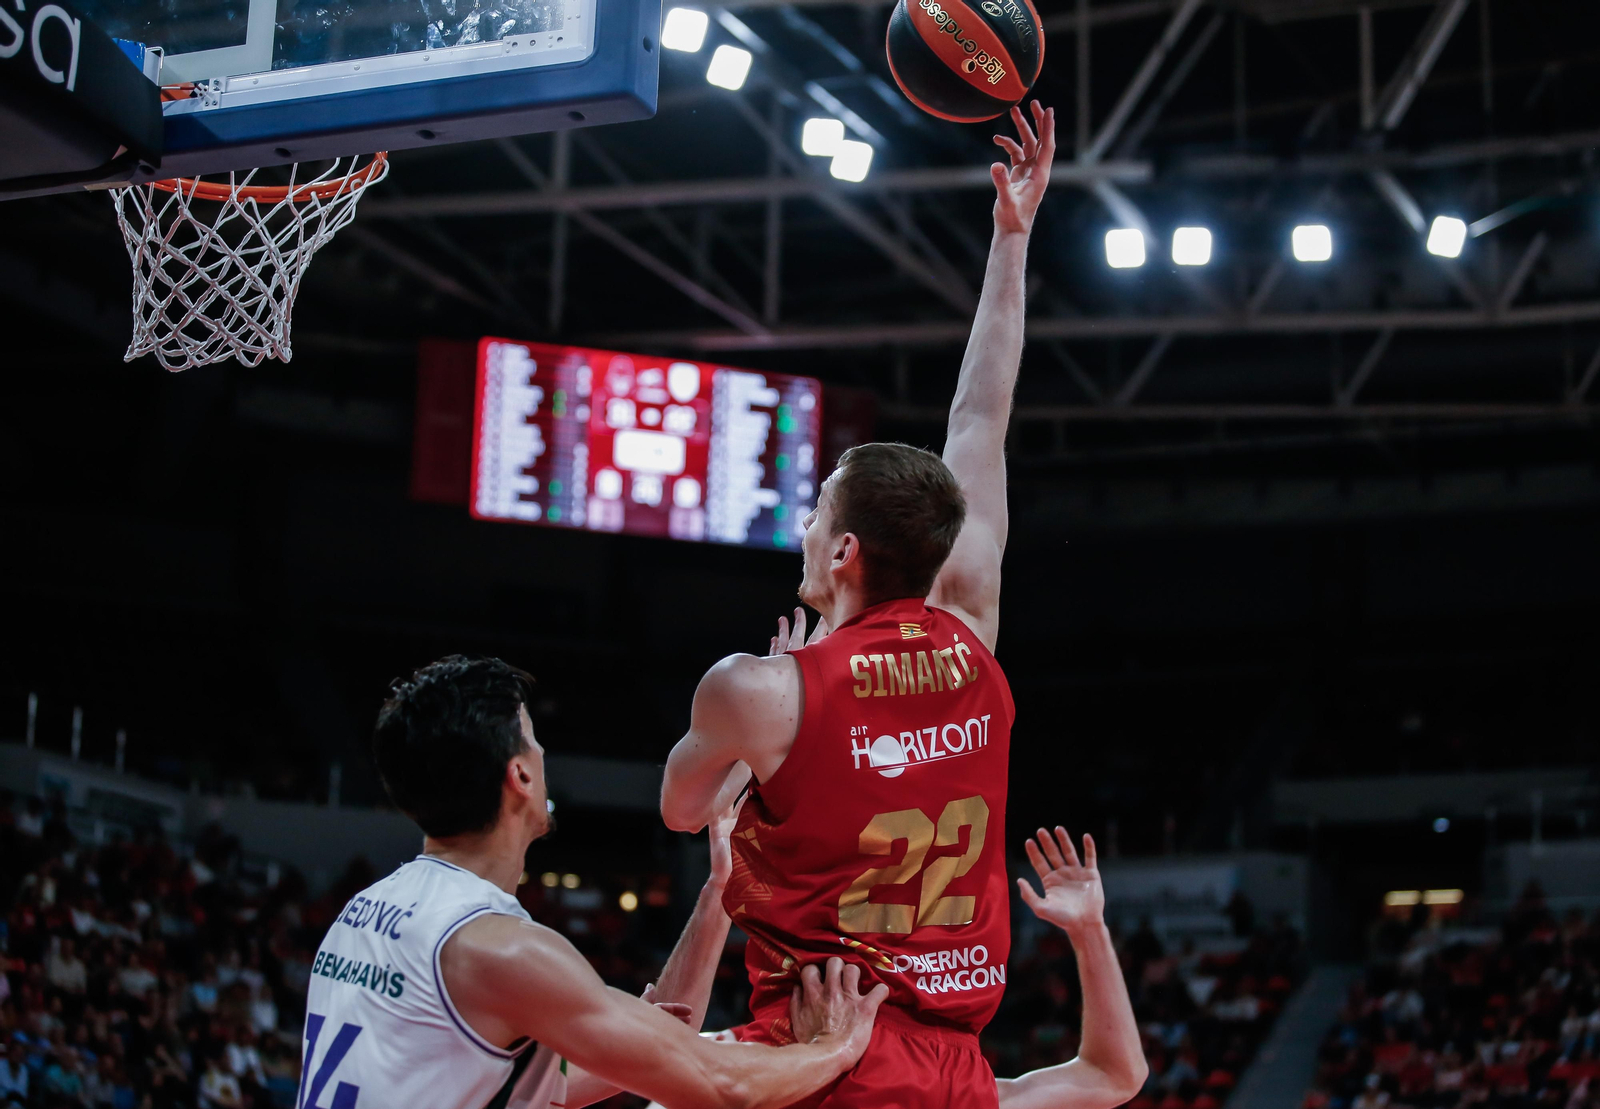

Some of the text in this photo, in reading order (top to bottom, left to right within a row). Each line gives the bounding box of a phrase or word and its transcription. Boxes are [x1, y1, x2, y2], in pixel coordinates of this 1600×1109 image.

[973, 49, 1006, 85] liga
[850, 725, 868, 736] air
[838, 795, 990, 934] 22
[884, 945, 988, 974] OBIERNO
